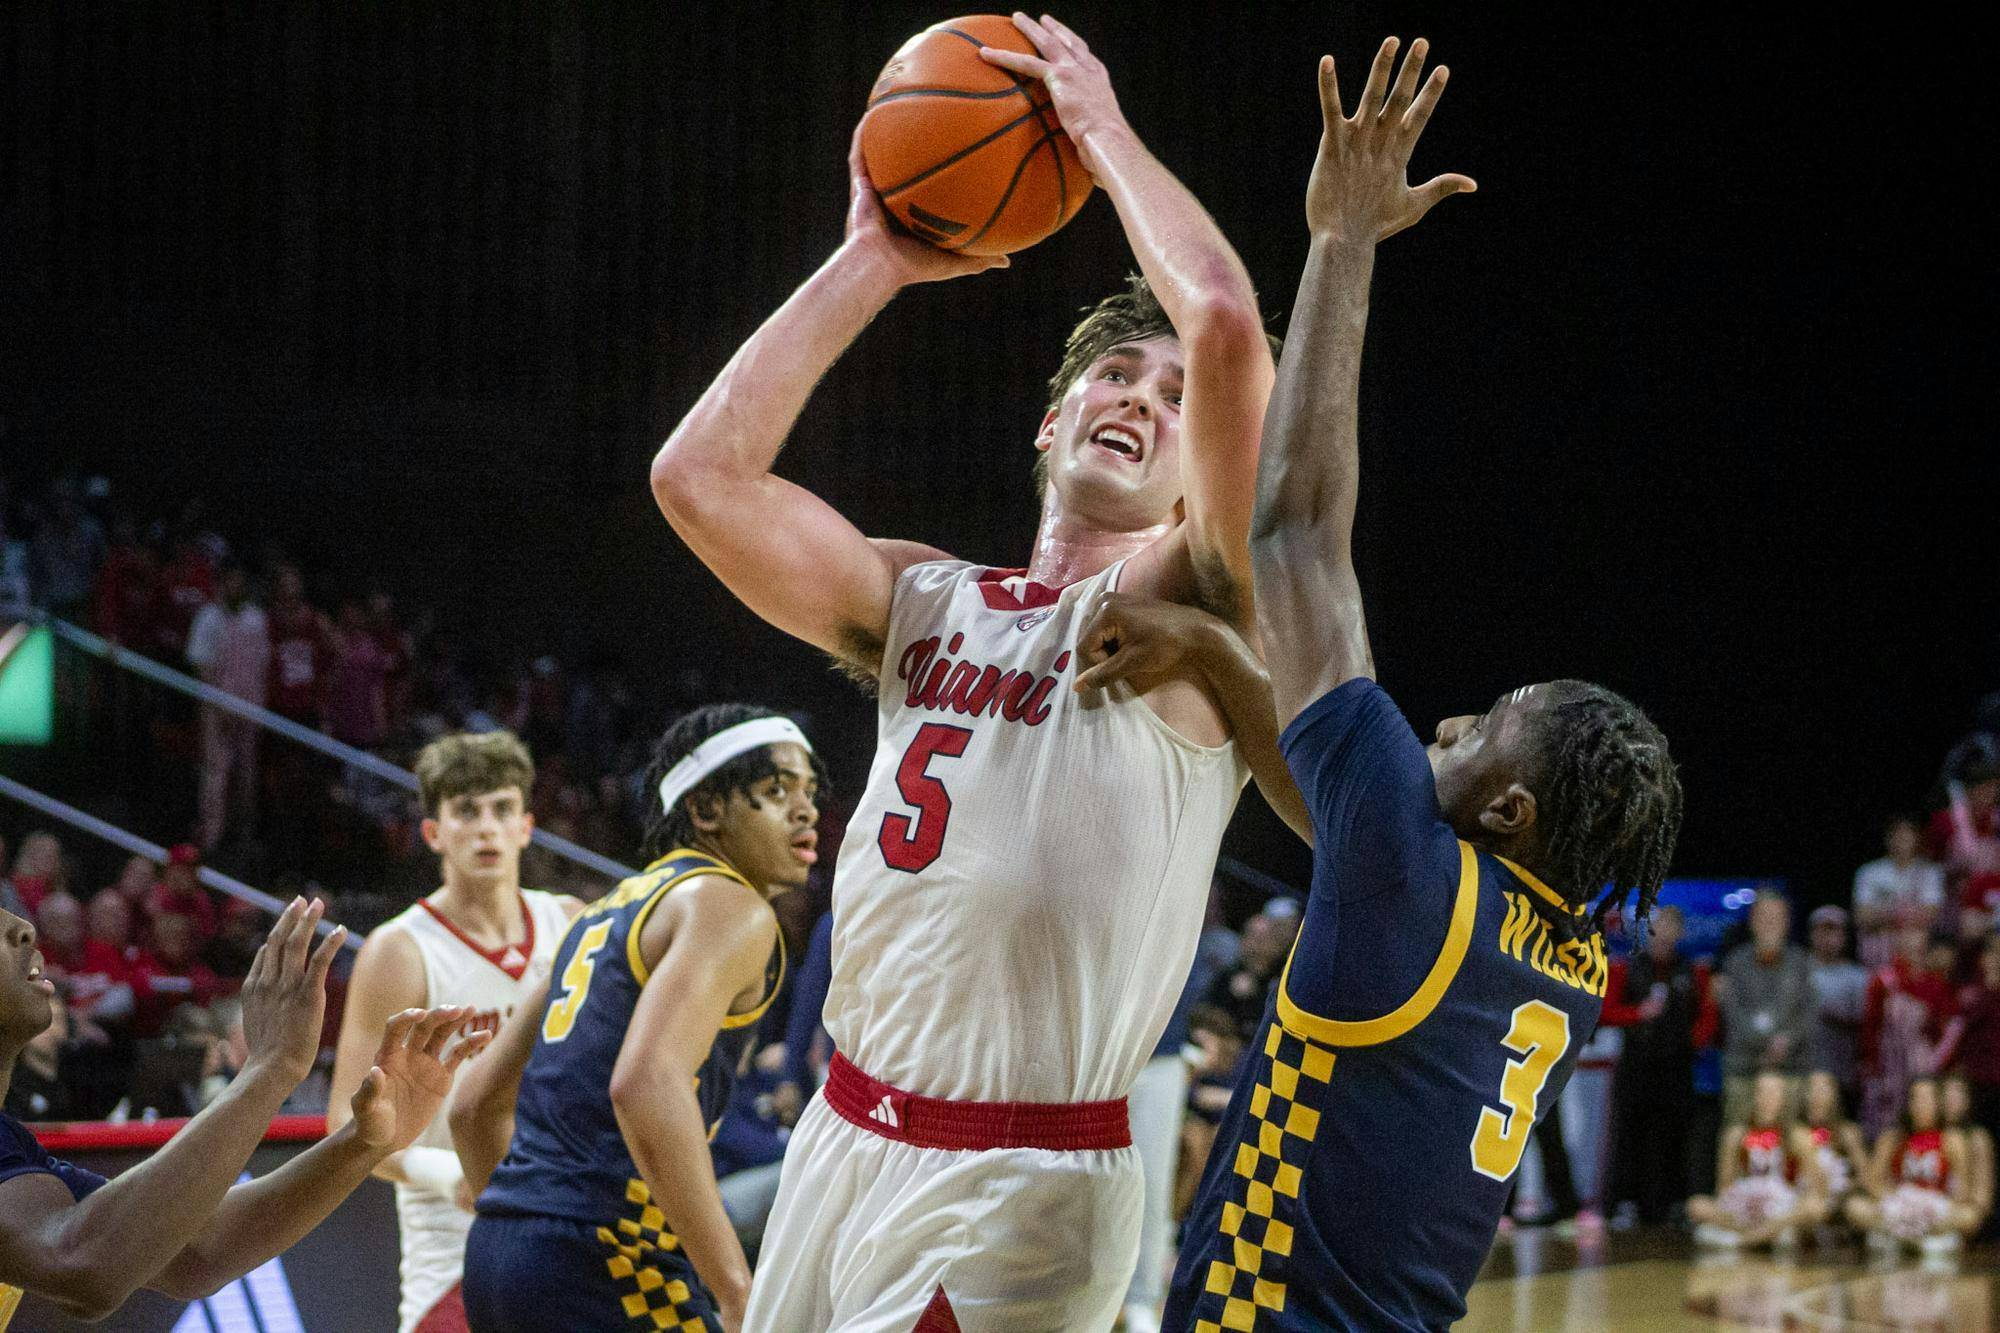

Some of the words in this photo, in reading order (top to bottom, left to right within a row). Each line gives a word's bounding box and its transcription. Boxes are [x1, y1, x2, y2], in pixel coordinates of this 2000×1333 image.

[879, 722, 974, 874] 5
[542, 918, 614, 1044] 5
[1500, 891, 1608, 998] WILSON
[1470, 999, 1571, 1183] 3
